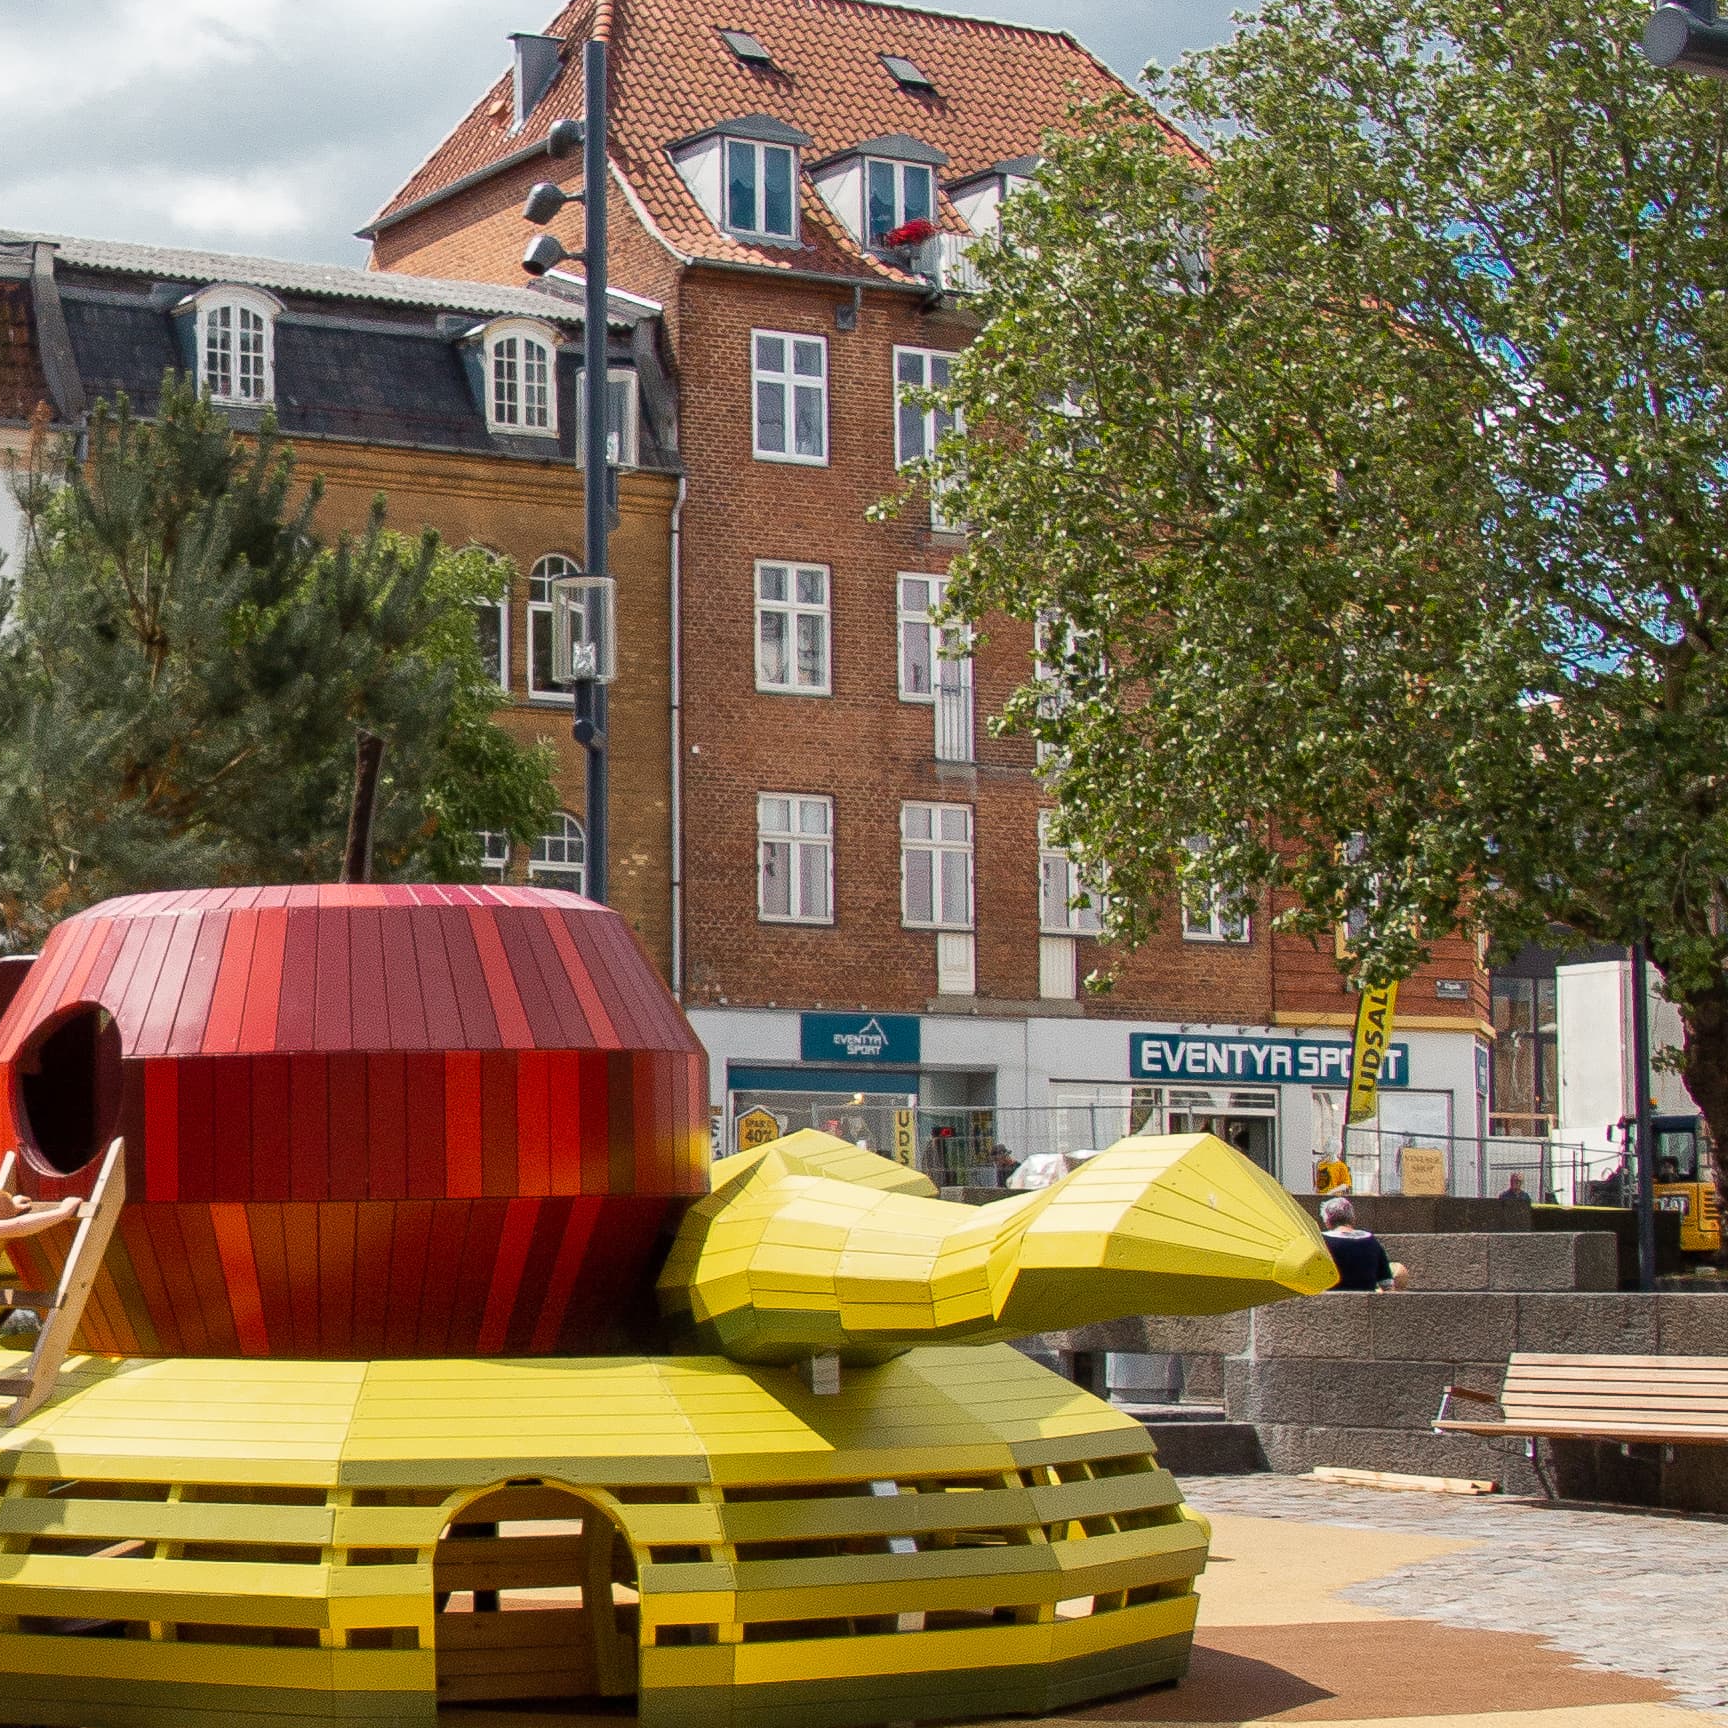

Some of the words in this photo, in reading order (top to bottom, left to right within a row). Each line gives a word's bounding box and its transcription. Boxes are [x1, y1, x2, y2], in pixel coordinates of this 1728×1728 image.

[833, 1034, 881, 1047] EVENTYR
[847, 1045, 881, 1055] SPORT
[1141, 1040, 1292, 1077] EVENTYR
[1298, 1047, 1402, 1080] SPOT
